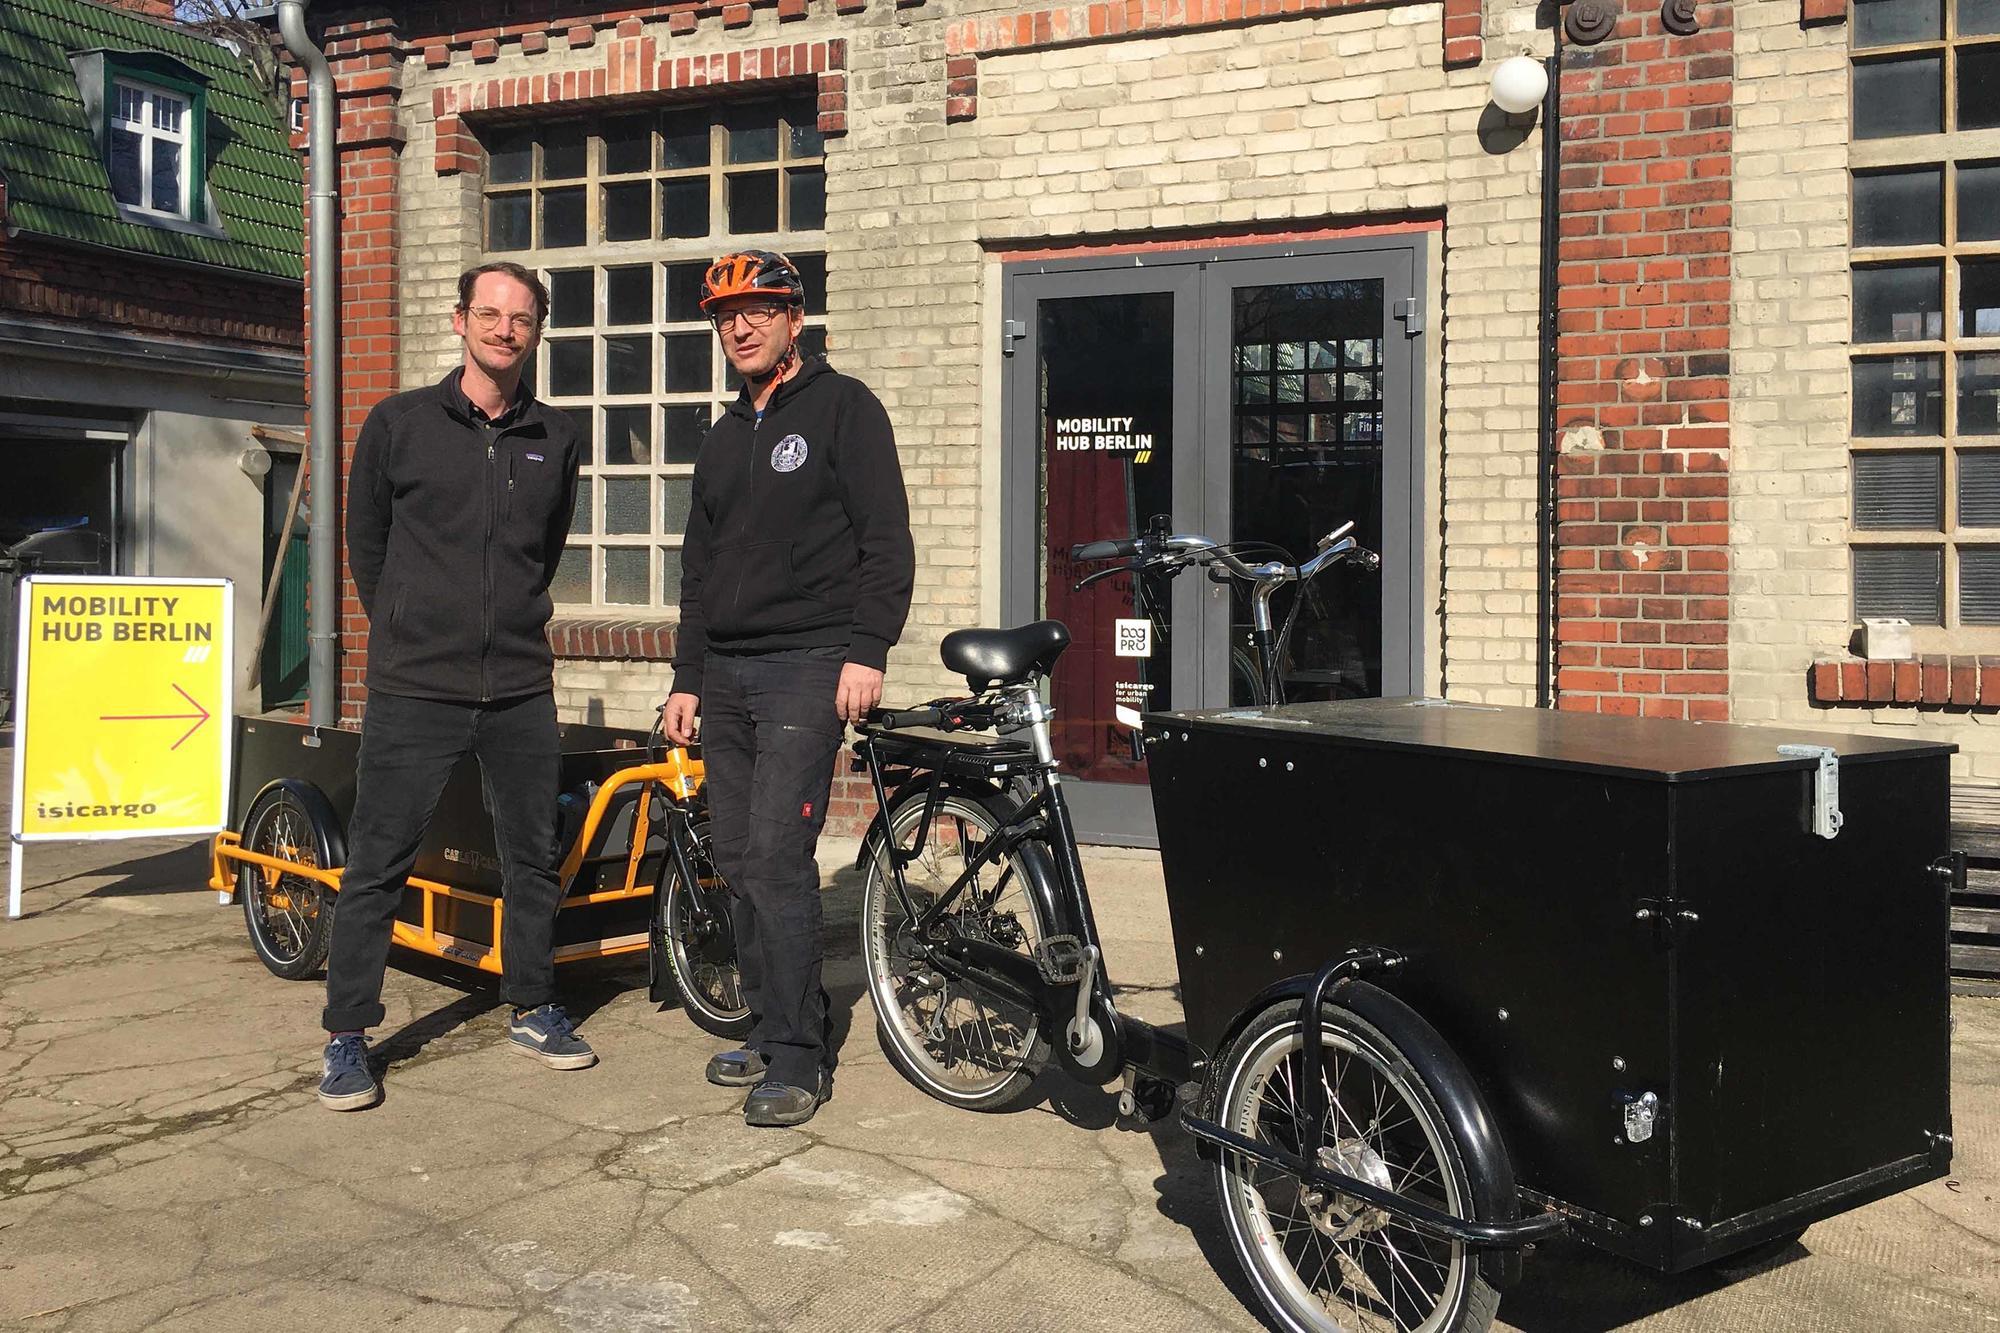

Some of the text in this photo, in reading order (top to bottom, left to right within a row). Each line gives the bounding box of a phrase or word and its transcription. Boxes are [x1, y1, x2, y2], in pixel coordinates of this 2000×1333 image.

[1056, 417, 1133, 433] MOBILITY
[1056, 434, 1152, 451] HUB BERLIN
[43, 596, 179, 616] MOBILITY
[42, 622, 212, 642] HUB BERLIN
[37, 801, 156, 818] isicargo
